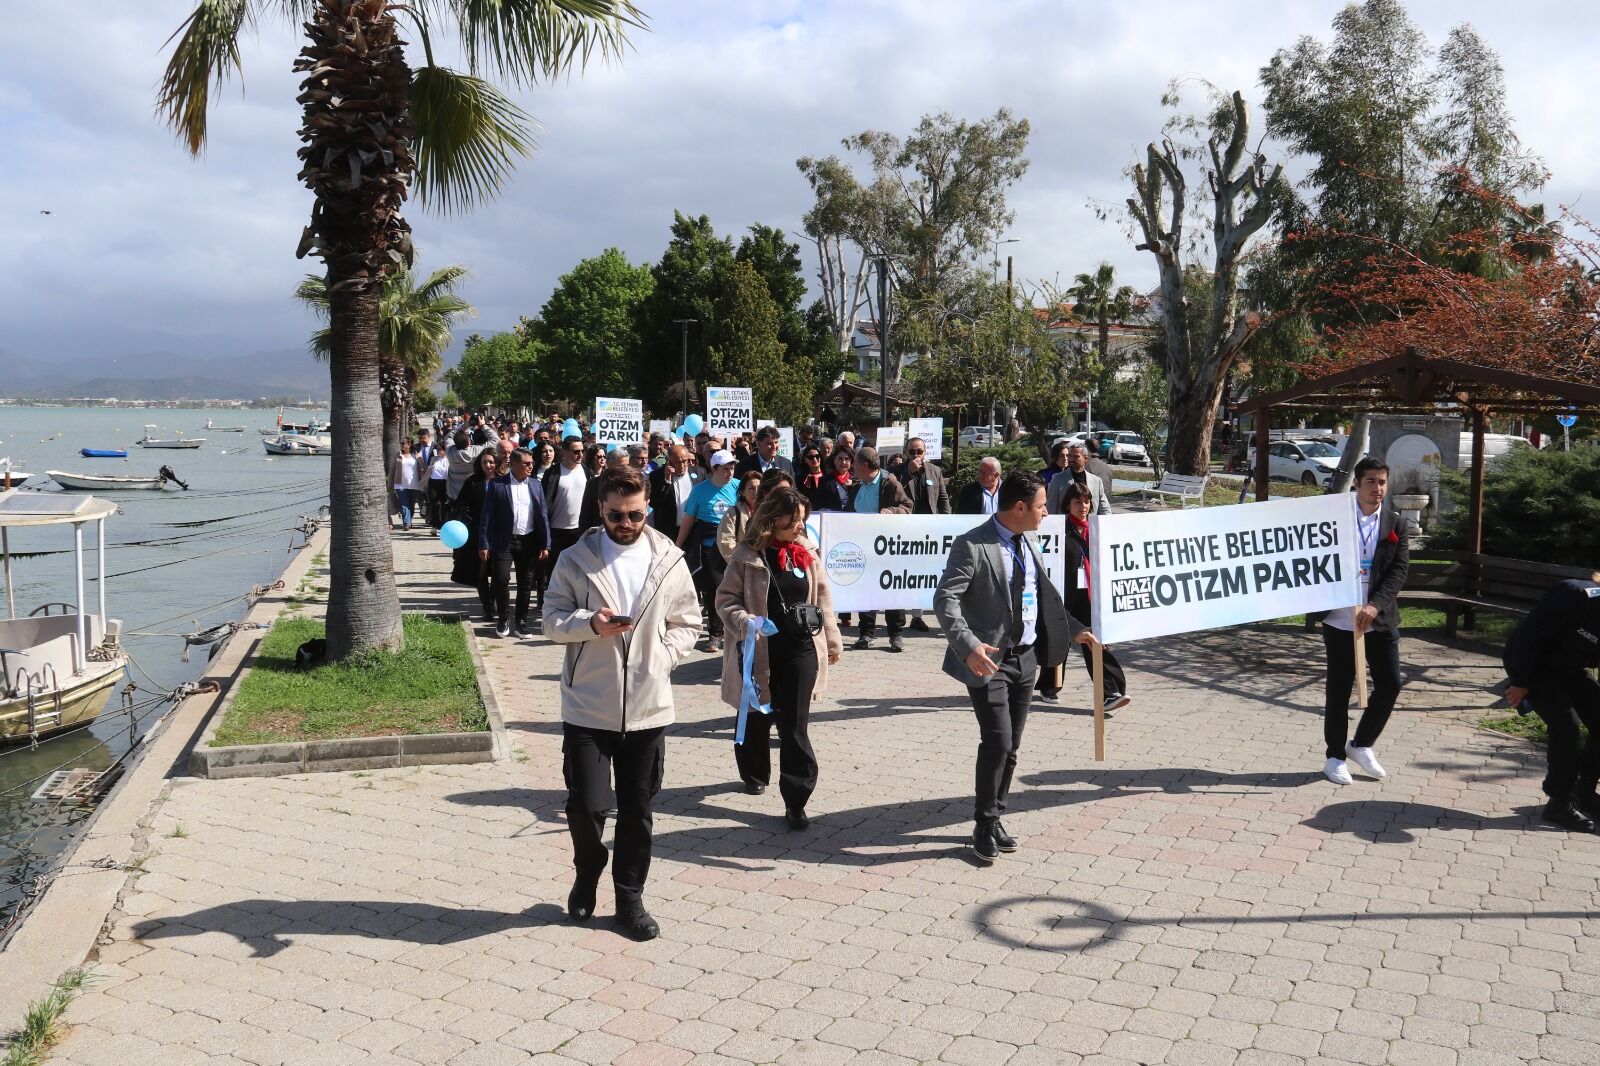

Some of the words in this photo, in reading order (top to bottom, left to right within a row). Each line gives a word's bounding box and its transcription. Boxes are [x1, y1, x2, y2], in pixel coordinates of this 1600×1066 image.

[710, 419, 750, 429] PARKI
[599, 430, 639, 442] PARKI
[873, 534, 938, 556] Otizmin
[1110, 542, 1139, 572] T.C.
[879, 569, 937, 590] Onların
[1253, 552, 1342, 593] PARKI
[1115, 594, 1151, 612] METE
